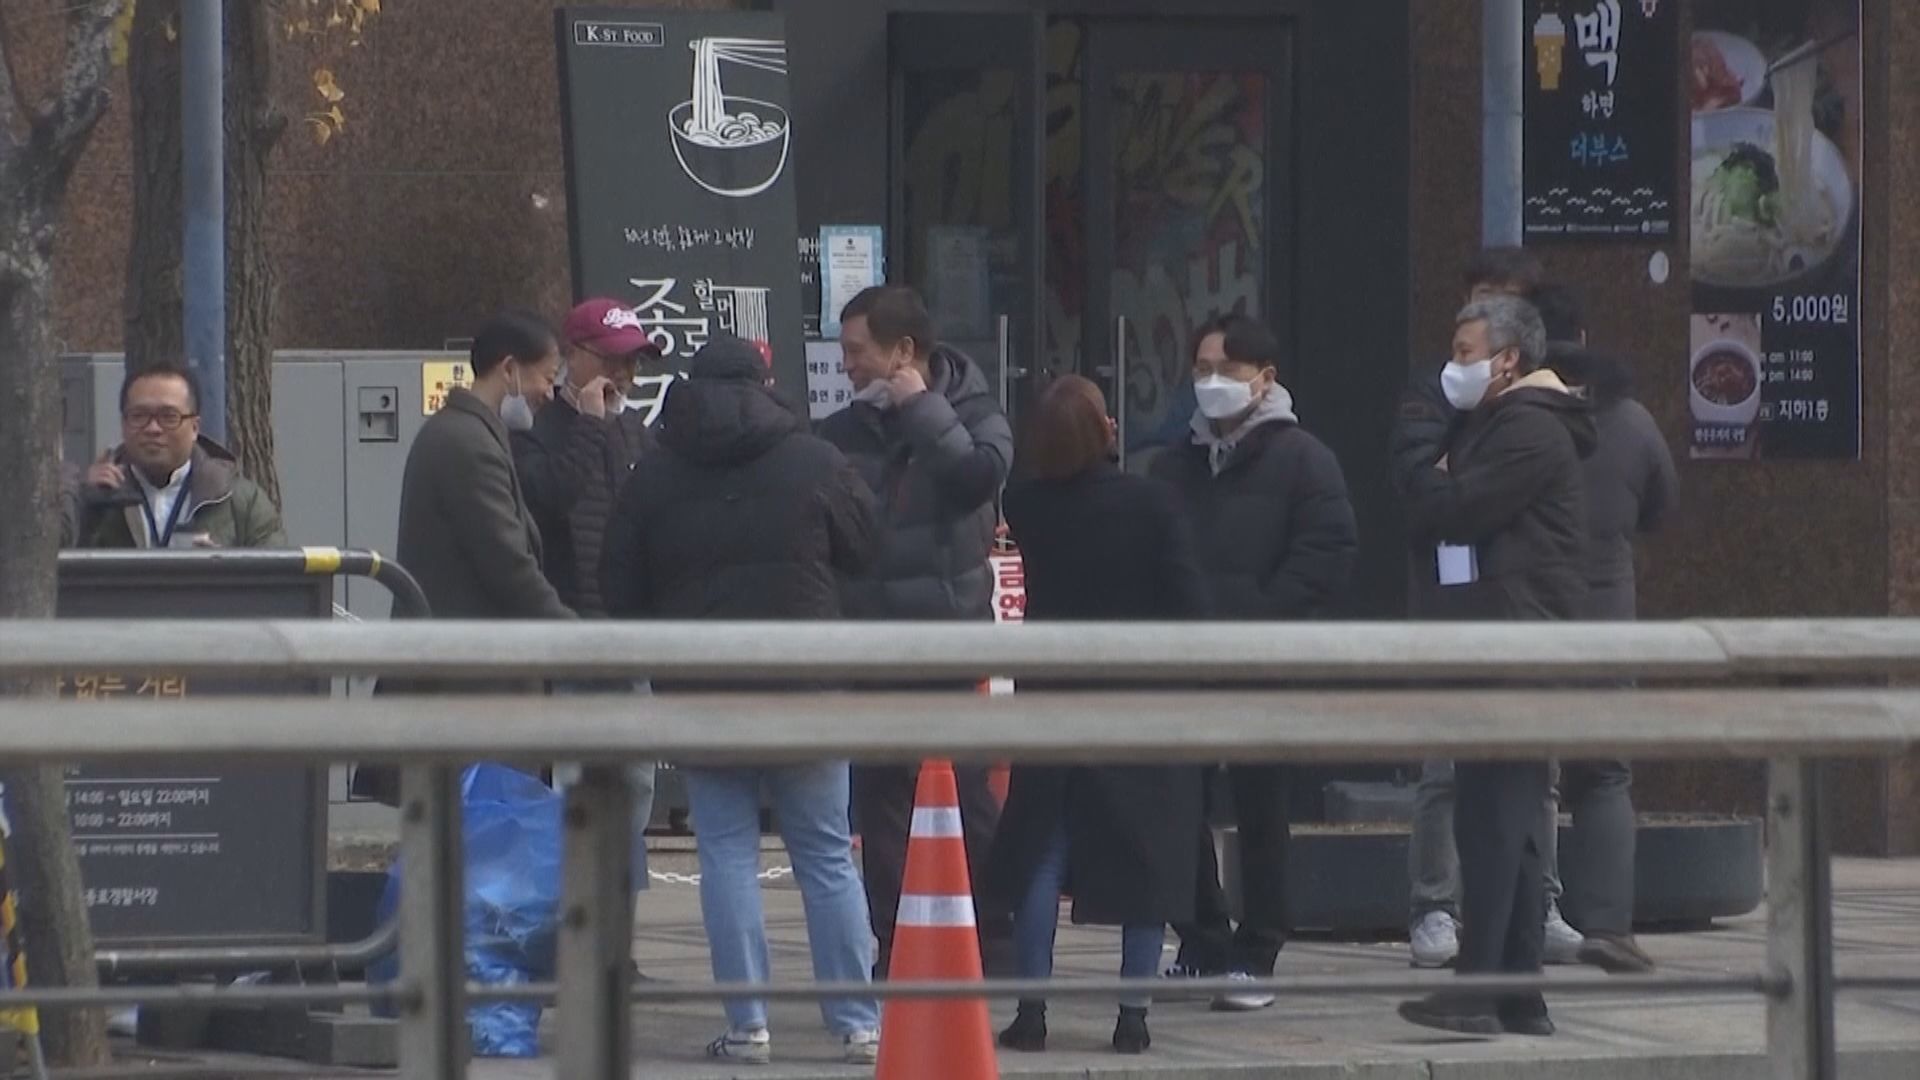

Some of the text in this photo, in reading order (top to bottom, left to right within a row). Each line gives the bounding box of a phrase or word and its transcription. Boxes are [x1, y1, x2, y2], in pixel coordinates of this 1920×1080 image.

[623, 29, 653, 43] FOOD
[1574, 1, 1622, 87] 맥
[1581, 90, 1614, 119] 하면
[1570, 131, 1629, 167] 더부스
[692, 278, 735, 335] 할머니
[1772, 294, 1848, 325] 5,000원
[1779, 399, 1829, 422] 지하1층
